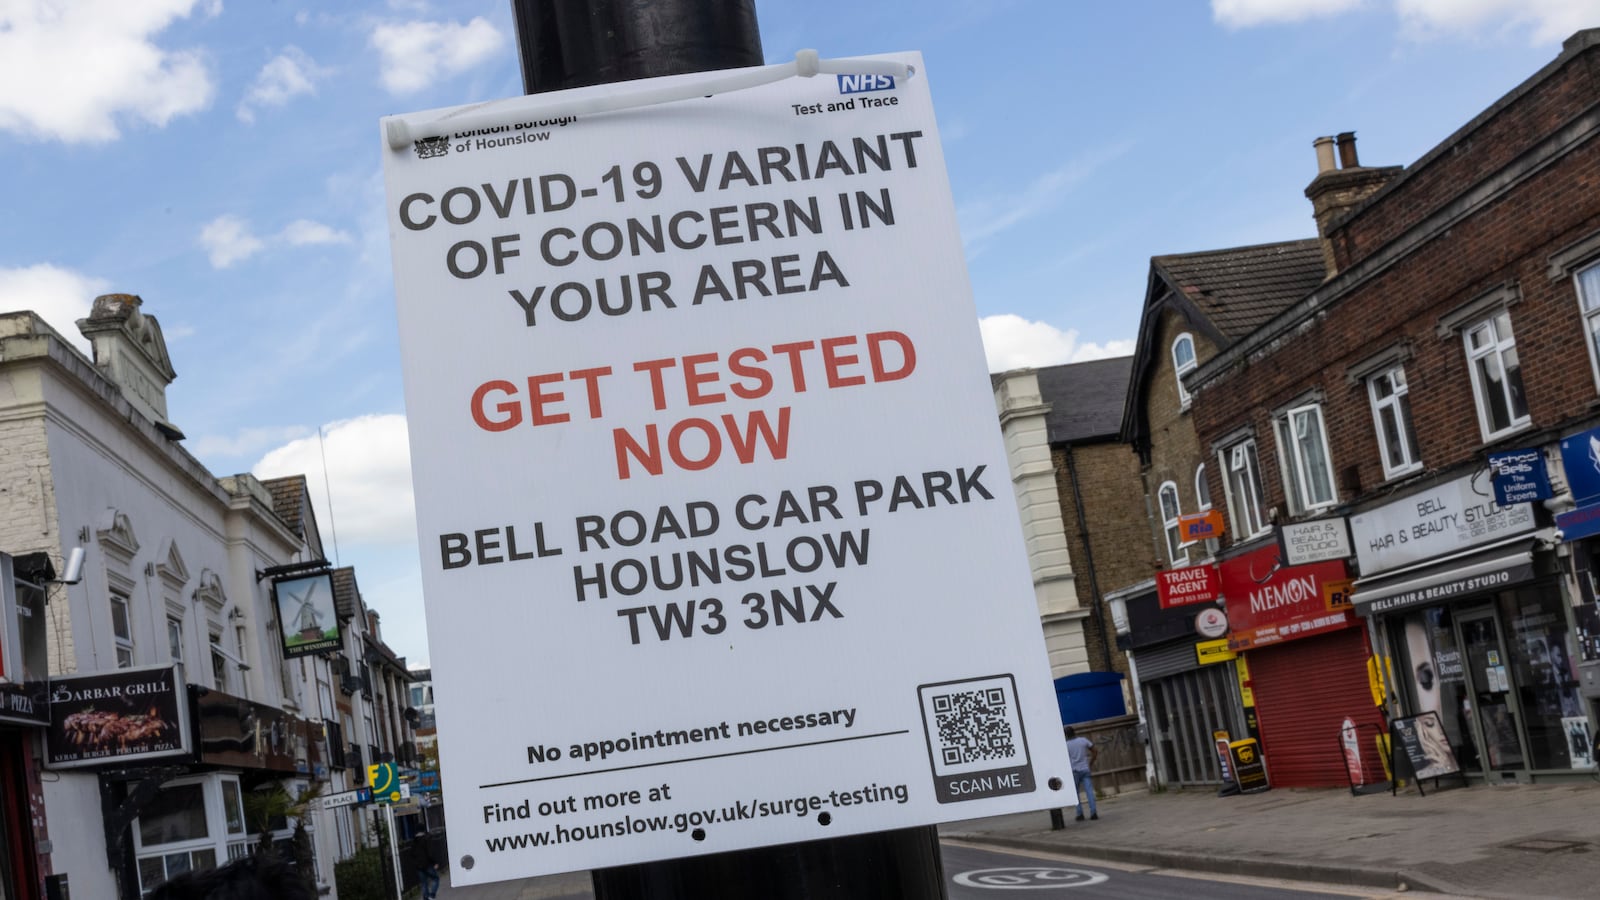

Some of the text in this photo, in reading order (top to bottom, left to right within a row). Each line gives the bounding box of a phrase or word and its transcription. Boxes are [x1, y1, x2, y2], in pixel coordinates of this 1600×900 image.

[842, 74, 891, 92] NHS
[792, 96, 898, 116] Test and Trace
[455, 132, 550, 152] of Hounslow
[399, 130, 923, 231] COVID-19 VARIANT
[446, 187, 896, 280] OF CONCERN IN
[509, 250, 850, 327] YOUR AREA
[470, 330, 917, 432] GET TESTED
[613, 406, 792, 480] NOW
[1503, 482, 1536, 493] Uniform
[1506, 491, 1538, 502] Experts
[1417, 497, 1446, 517] BELL
[439, 465, 995, 570] BELL ROAD CAR PARK
[1189, 519, 1213, 535] Ria
[1291, 531, 1338, 545] BEAUTY
[1293, 523, 1334, 536] HAIR &
[1369, 533, 1395, 552] HAIR
[1399, 529, 1409, 543] &
[1412, 513, 1459, 539] BEAUTY
[1296, 540, 1338, 553] STUDIO
[573, 529, 871, 602] HOUNSLOW
[1164, 568, 1208, 583] TRAVEL
[1169, 580, 1208, 595] AGENT
[1249, 574, 1318, 614] MEMON
[1331, 588, 1351, 606] Ri
[1371, 571, 1509, 612] BELL HAIR & BEAUTY STUDIO
[617, 582, 844, 645] TW3 3NX
[126, 681, 170, 695] GRILL
[11, 693, 33, 713] PIZZA
[527, 705, 858, 764] No appointment necessary
[154, 743, 174, 751] PIZZA
[949, 772, 1022, 797] SCAN ME
[333, 795, 353, 804] PLACE
[483, 783, 671, 825] Find out more at
[485, 781, 910, 854] www.hounslow.gov.uk/surge-testing
